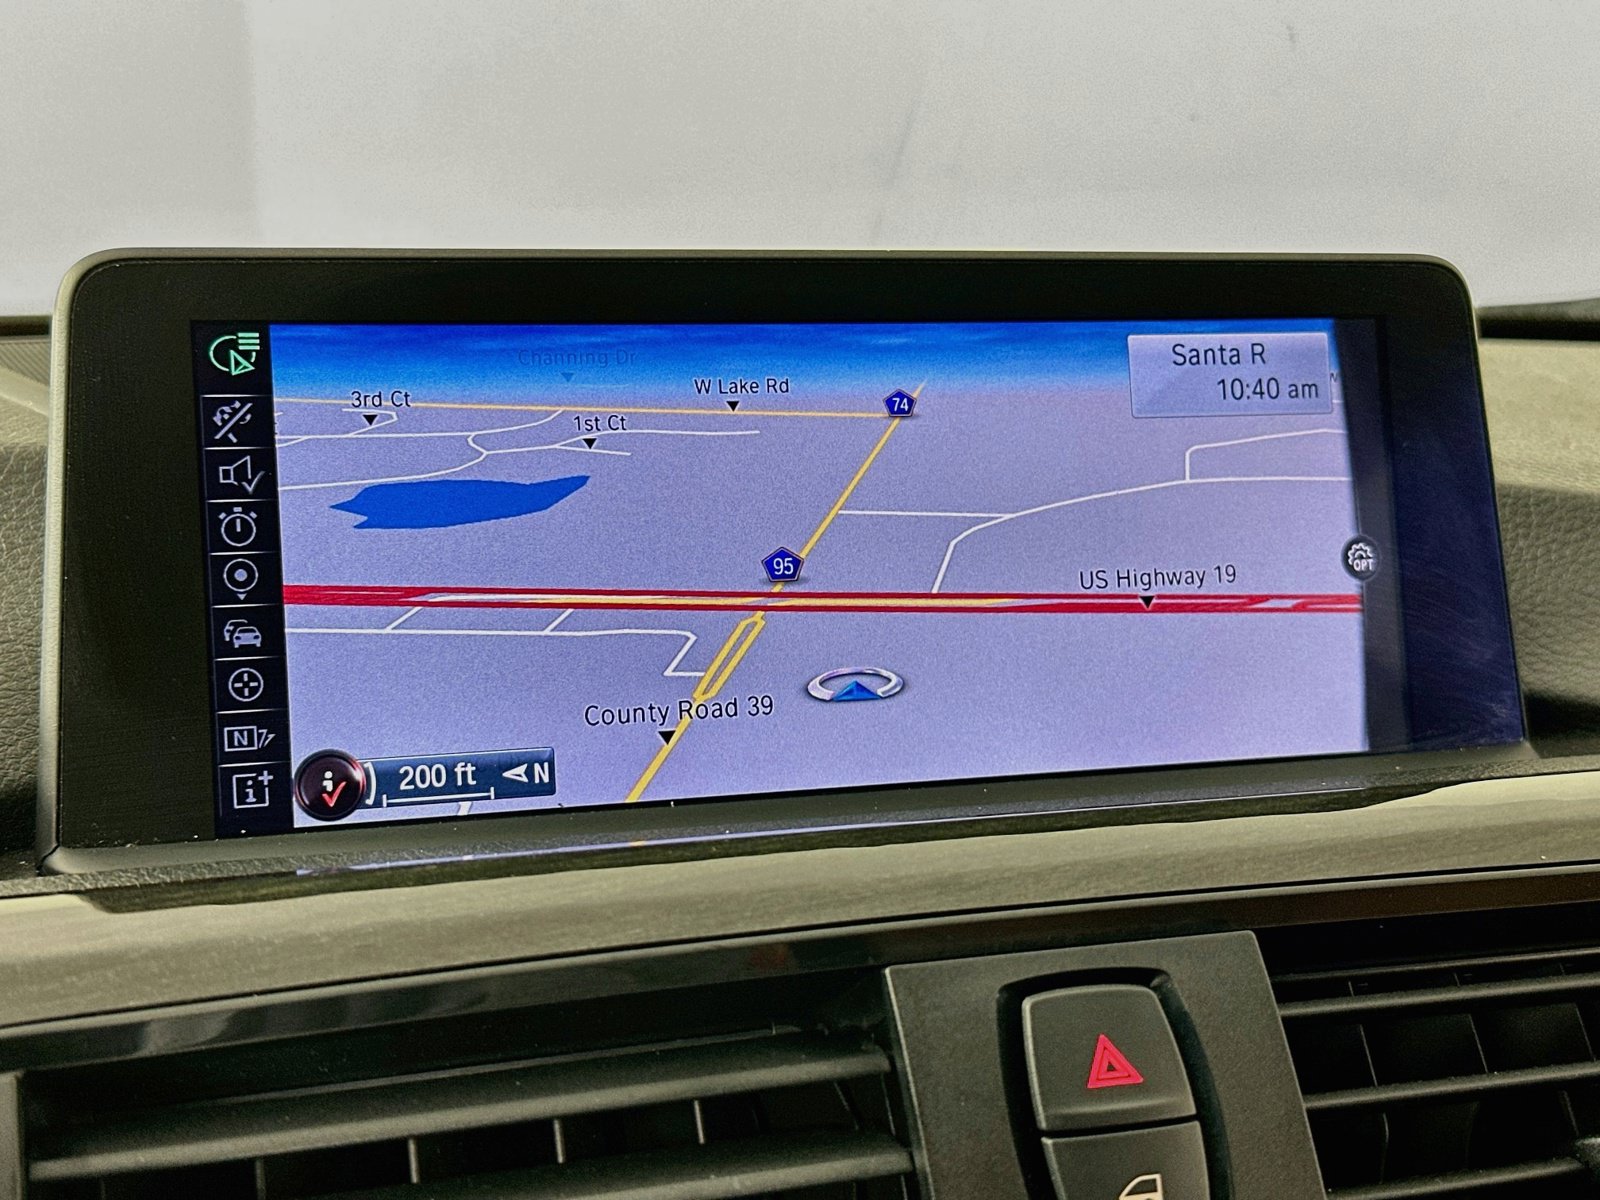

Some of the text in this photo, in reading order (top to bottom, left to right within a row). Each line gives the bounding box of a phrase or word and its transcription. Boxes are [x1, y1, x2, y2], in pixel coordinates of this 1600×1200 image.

[1171, 343, 1267, 366] Santa R
[693, 377, 790, 394] W Lake Rd
[1216, 377, 1319, 400] 10:40 am
[351, 389, 411, 407] 3rd Ct
[891, 397, 909, 412] 74
[573, 414, 627, 432] 1st Ct
[772, 557, 794, 575] 95
[1353, 558, 1374, 571] OPT
[1079, 564, 1237, 592] US Highway 19
[584, 694, 774, 727] County Road 39
[399, 762, 477, 790] 200 ft
[533, 761, 550, 784] N
